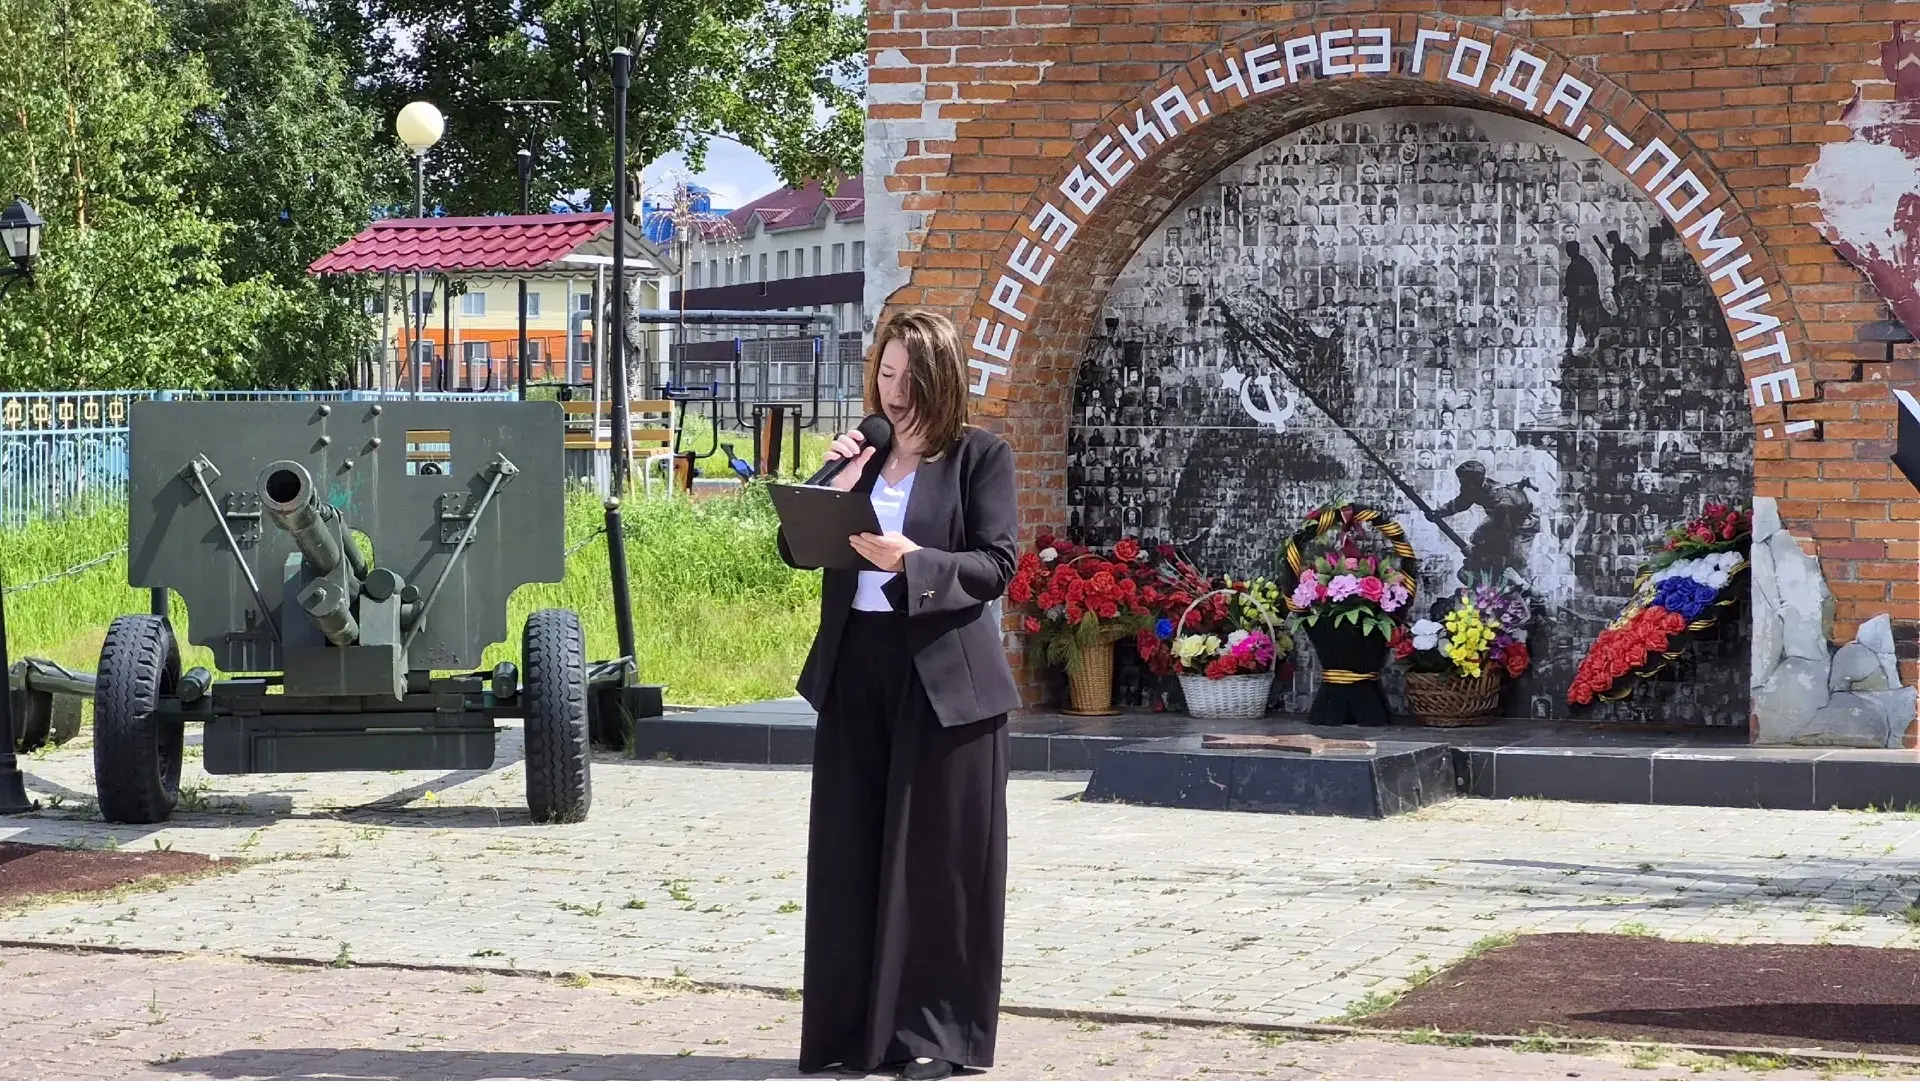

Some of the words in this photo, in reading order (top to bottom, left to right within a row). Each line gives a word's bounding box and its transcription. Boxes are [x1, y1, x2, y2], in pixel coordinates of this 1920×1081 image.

[967, 201, 1079, 396] ЧЕРЕЗ
[1058, 84, 1211, 216] ВЕКА,
[1205, 27, 1391, 99] ЧЕРЕЗ
